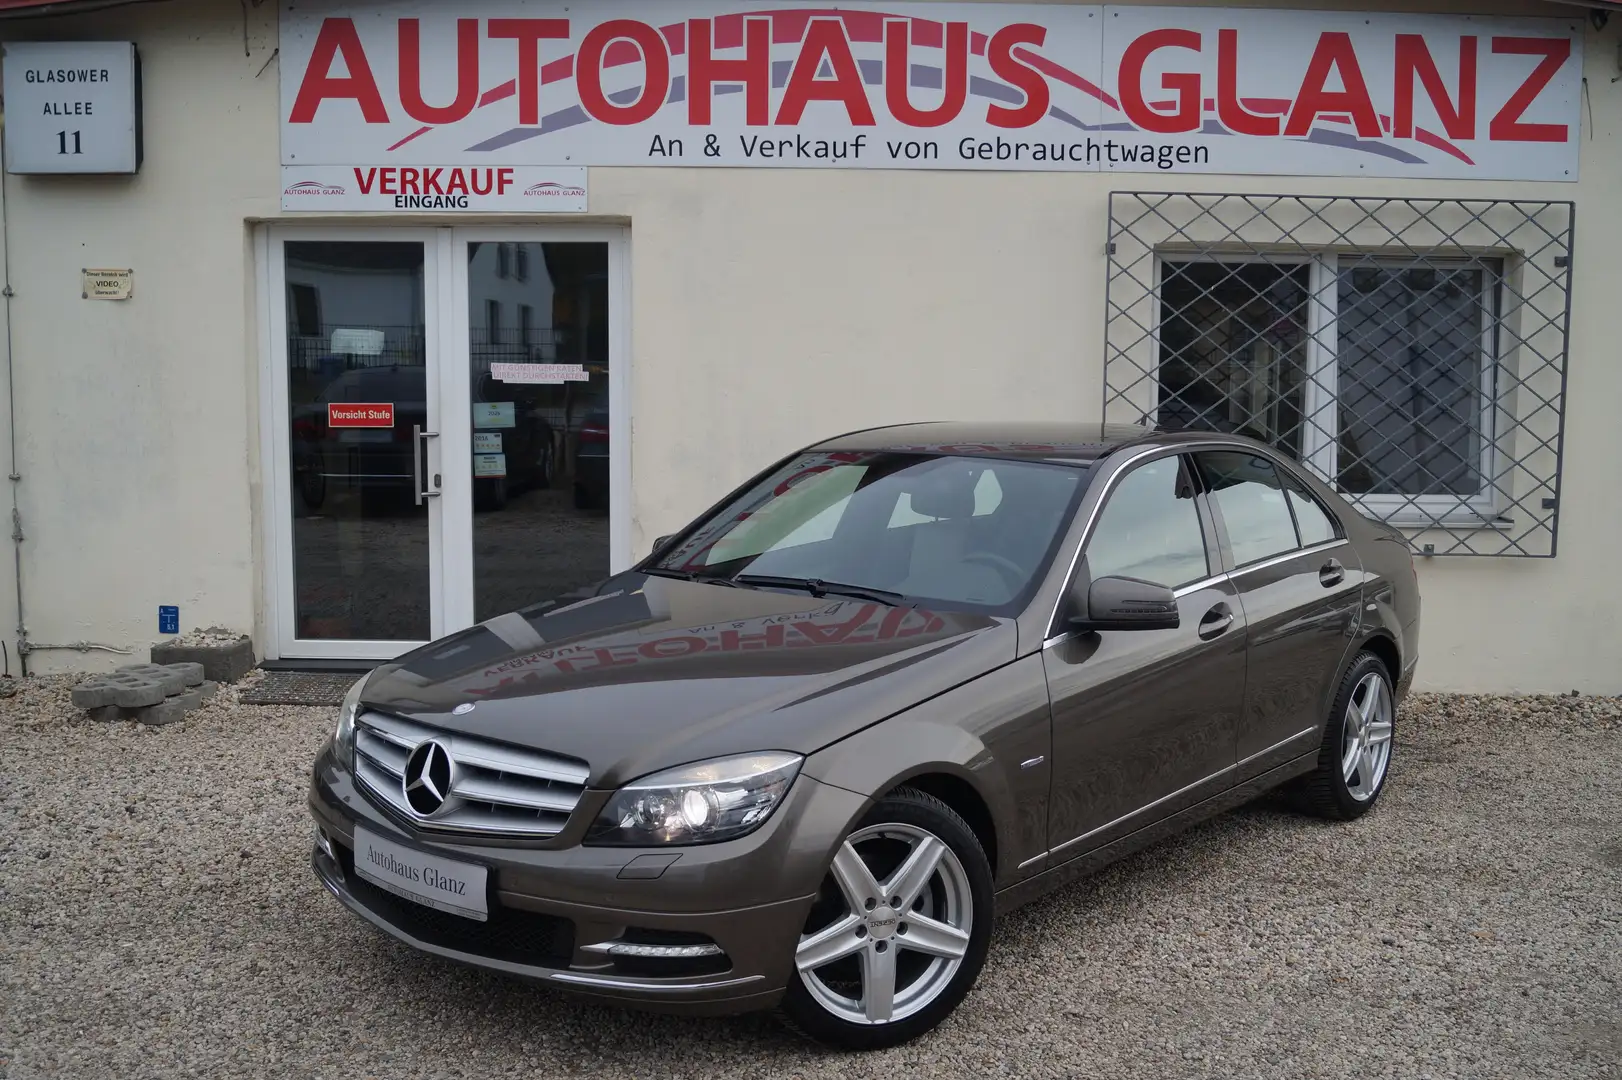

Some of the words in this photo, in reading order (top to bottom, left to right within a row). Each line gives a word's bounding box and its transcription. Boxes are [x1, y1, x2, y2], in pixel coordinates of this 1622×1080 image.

[25, 69, 109, 83] GLASOWER
[289, 17, 1049, 130] AUTOHAUS
[1117, 28, 1571, 143] GLANZ
[43, 102, 93, 115] ALLEE
[56, 130, 84, 155] 11
[649, 135, 683, 157] An
[703, 134, 721, 157] &
[740, 134, 866, 159] Verkauf
[887, 141, 938, 160] von
[958, 136, 1209, 169] Gebrauchtwagen
[353, 167, 514, 196] VERKAUF
[395, 195, 468, 208] EINGANG
[96, 280, 119, 288] VIDEO
[332, 410, 367, 419] Vorsicht
[368, 410, 391, 419] Stufe
[367, 844, 420, 882] Autohaus
[423, 867, 466, 896] Glanz
